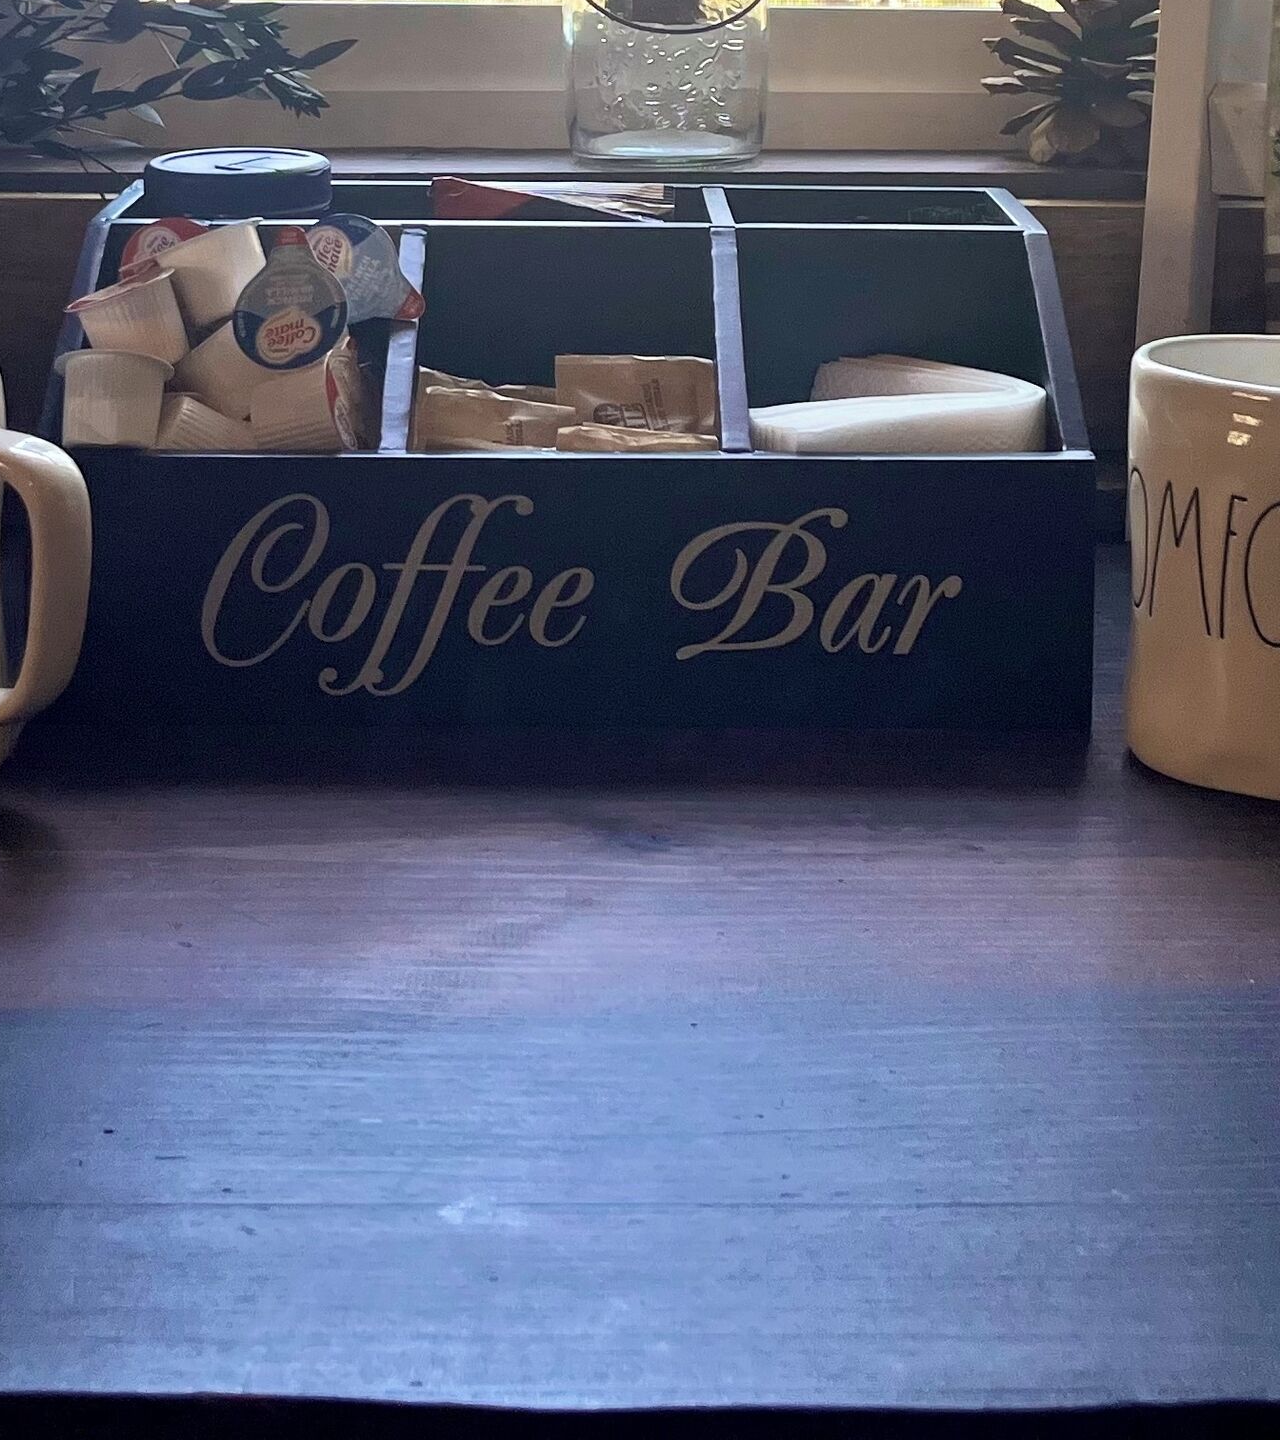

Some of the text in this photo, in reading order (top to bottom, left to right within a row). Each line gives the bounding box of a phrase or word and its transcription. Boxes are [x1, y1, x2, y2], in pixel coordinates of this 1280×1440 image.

[267, 325, 317, 348] Coffee
[200, 492, 963, 697] Coffee Bar
